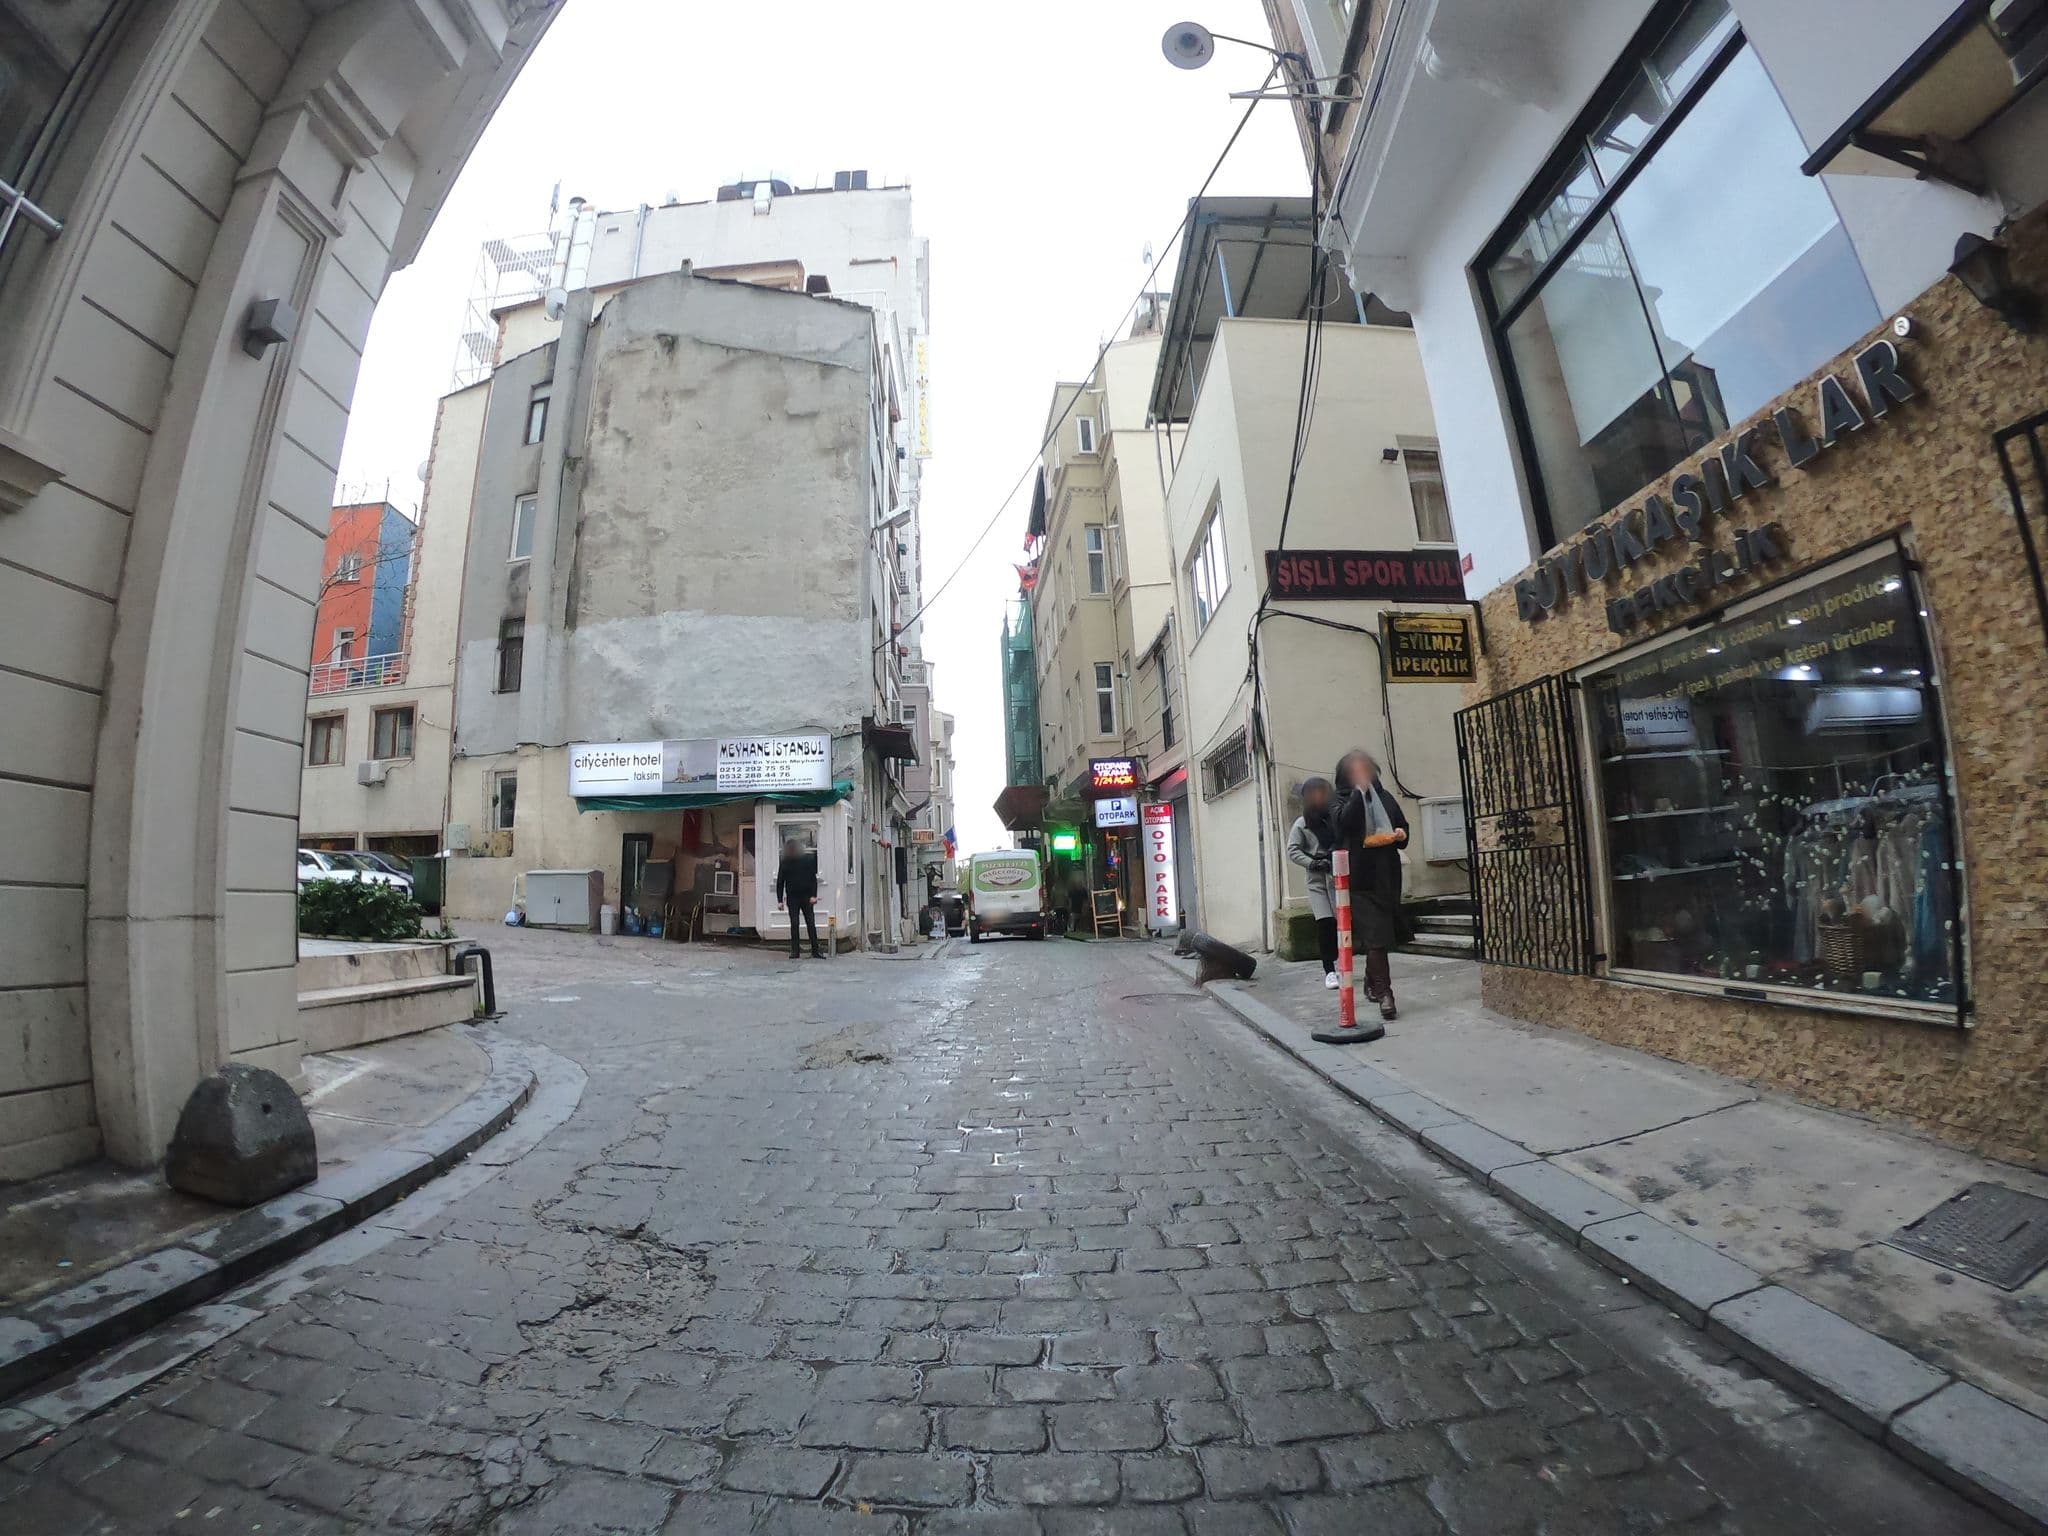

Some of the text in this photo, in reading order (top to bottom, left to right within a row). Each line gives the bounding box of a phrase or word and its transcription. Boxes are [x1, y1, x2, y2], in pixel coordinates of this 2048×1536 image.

[1277, 556, 1336, 592] ŞİŞLİ
[1343, 558, 1408, 586] SPOR
[1409, 632, 1463, 652] YILMAZ
[1784, 640, 1829, 664] keten
[1832, 619, 1897, 651] ürünler
[1395, 650, 1469, 677] İPEKÇİLİK
[720, 739, 824, 758] MEYHANE İSTANBUL
[574, 752, 661, 770] citycenter hotel
[1093, 761, 1132, 771] OTOPARK
[633, 771, 660, 781] taksim
[1093, 776, 1113, 786] 7/24
[1098, 810, 1136, 820] OTOPARK
[1151, 830, 1170, 917] OTO PARK
